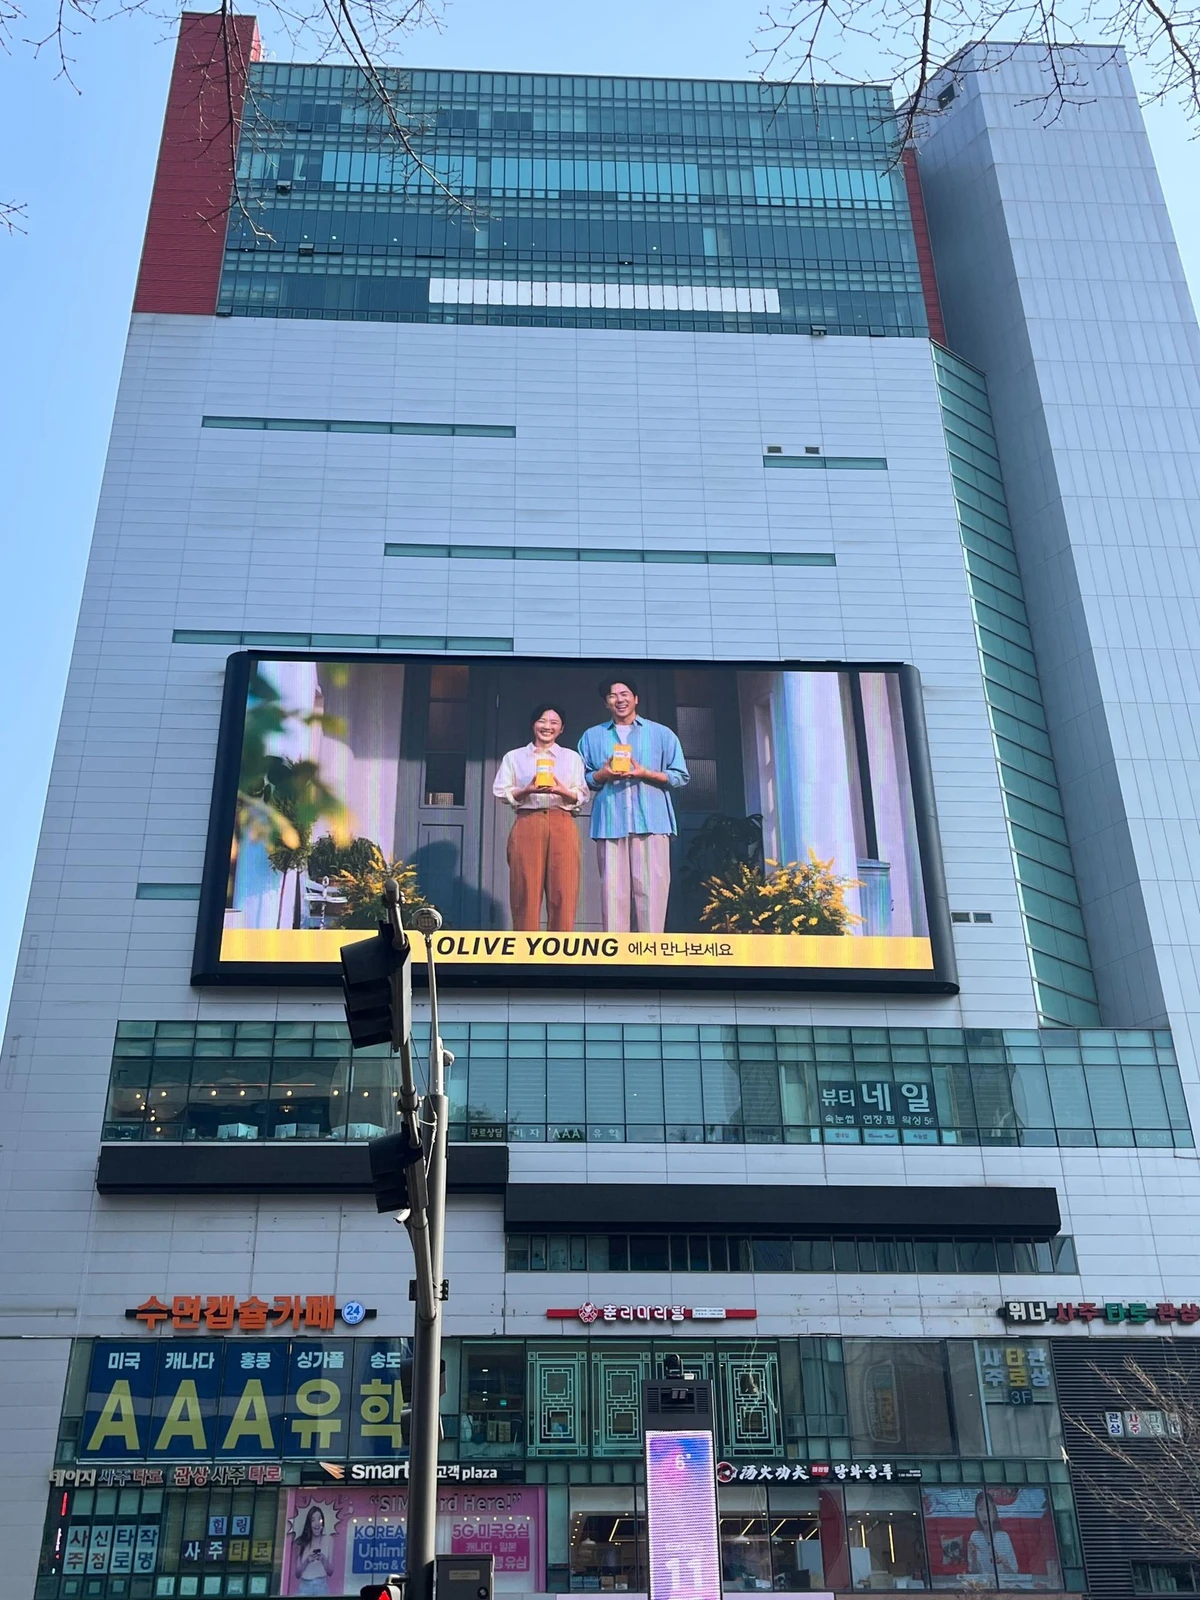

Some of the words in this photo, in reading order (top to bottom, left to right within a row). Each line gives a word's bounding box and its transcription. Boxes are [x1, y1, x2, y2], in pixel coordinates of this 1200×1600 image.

[437, 936, 516, 955] OLIVE
[526, 937, 619, 957] YOUNG
[628, 941, 657, 956] 에서
[660, 941, 734, 957] 만나보세요
[821, 1089, 856, 1107] 뷰티
[861, 1083, 931, 1113] 네일
[825, 1114, 855, 1125] 속눈썹
[924, 1116, 934, 1126] 5F
[470, 1127, 503, 1138] 무료상담
[552, 1128, 581, 1138] AAA
[136, 1295, 336, 1330] 수면캡슐카페
[346, 1305, 360, 1316] 24
[603, 1303, 685, 1321] 춘리마라탕
[1008, 1302, 1047, 1321] 위너
[1056, 1302, 1099, 1322] 사주
[1105, 1302, 1150, 1323] 타로
[1155, 1302, 1200, 1323] 관상
[107, 1352, 141, 1370] 미국
[165, 1352, 215, 1370] 캐나다
[240, 1352, 271, 1369] 홍콩
[297, 1351, 345, 1369] 싱가폴
[370, 1351, 401, 1369] 송도
[1011, 1390, 1031, 1405] 3F
[98, 1468, 131, 1487] 사주
[133, 1468, 164, 1487] 타로
[174, 1465, 210, 1486] 관상
[211, 1465, 245, 1485] 사주
[248, 1465, 282, 1485] 타로
[351, 1461, 409, 1479] smart
[437, 1465, 460, 1480] 고객
[462, 1466, 498, 1481] plaza
[834, 1463, 893, 1481] 탕화쿵푸
[213, 1517, 248, 1534] 힐링
[354, 1525, 406, 1539] KOREA
[452, 1523, 475, 1539] 5G
[477, 1523, 530, 1539] 미국유심
[67, 1529, 88, 1570] 사주
[91, 1529, 109, 1570] 신점
[113, 1529, 134, 1569] 타로
[138, 1529, 158, 1570] 작명
[184, 1541, 222, 1560] 사주
[231, 1541, 269, 1560] 타로
[358, 1542, 407, 1558] Unlimi
[364, 1560, 389, 1571] Data
[391, 1560, 399, 1570] &
[505, 1556, 527, 1569] 유심
